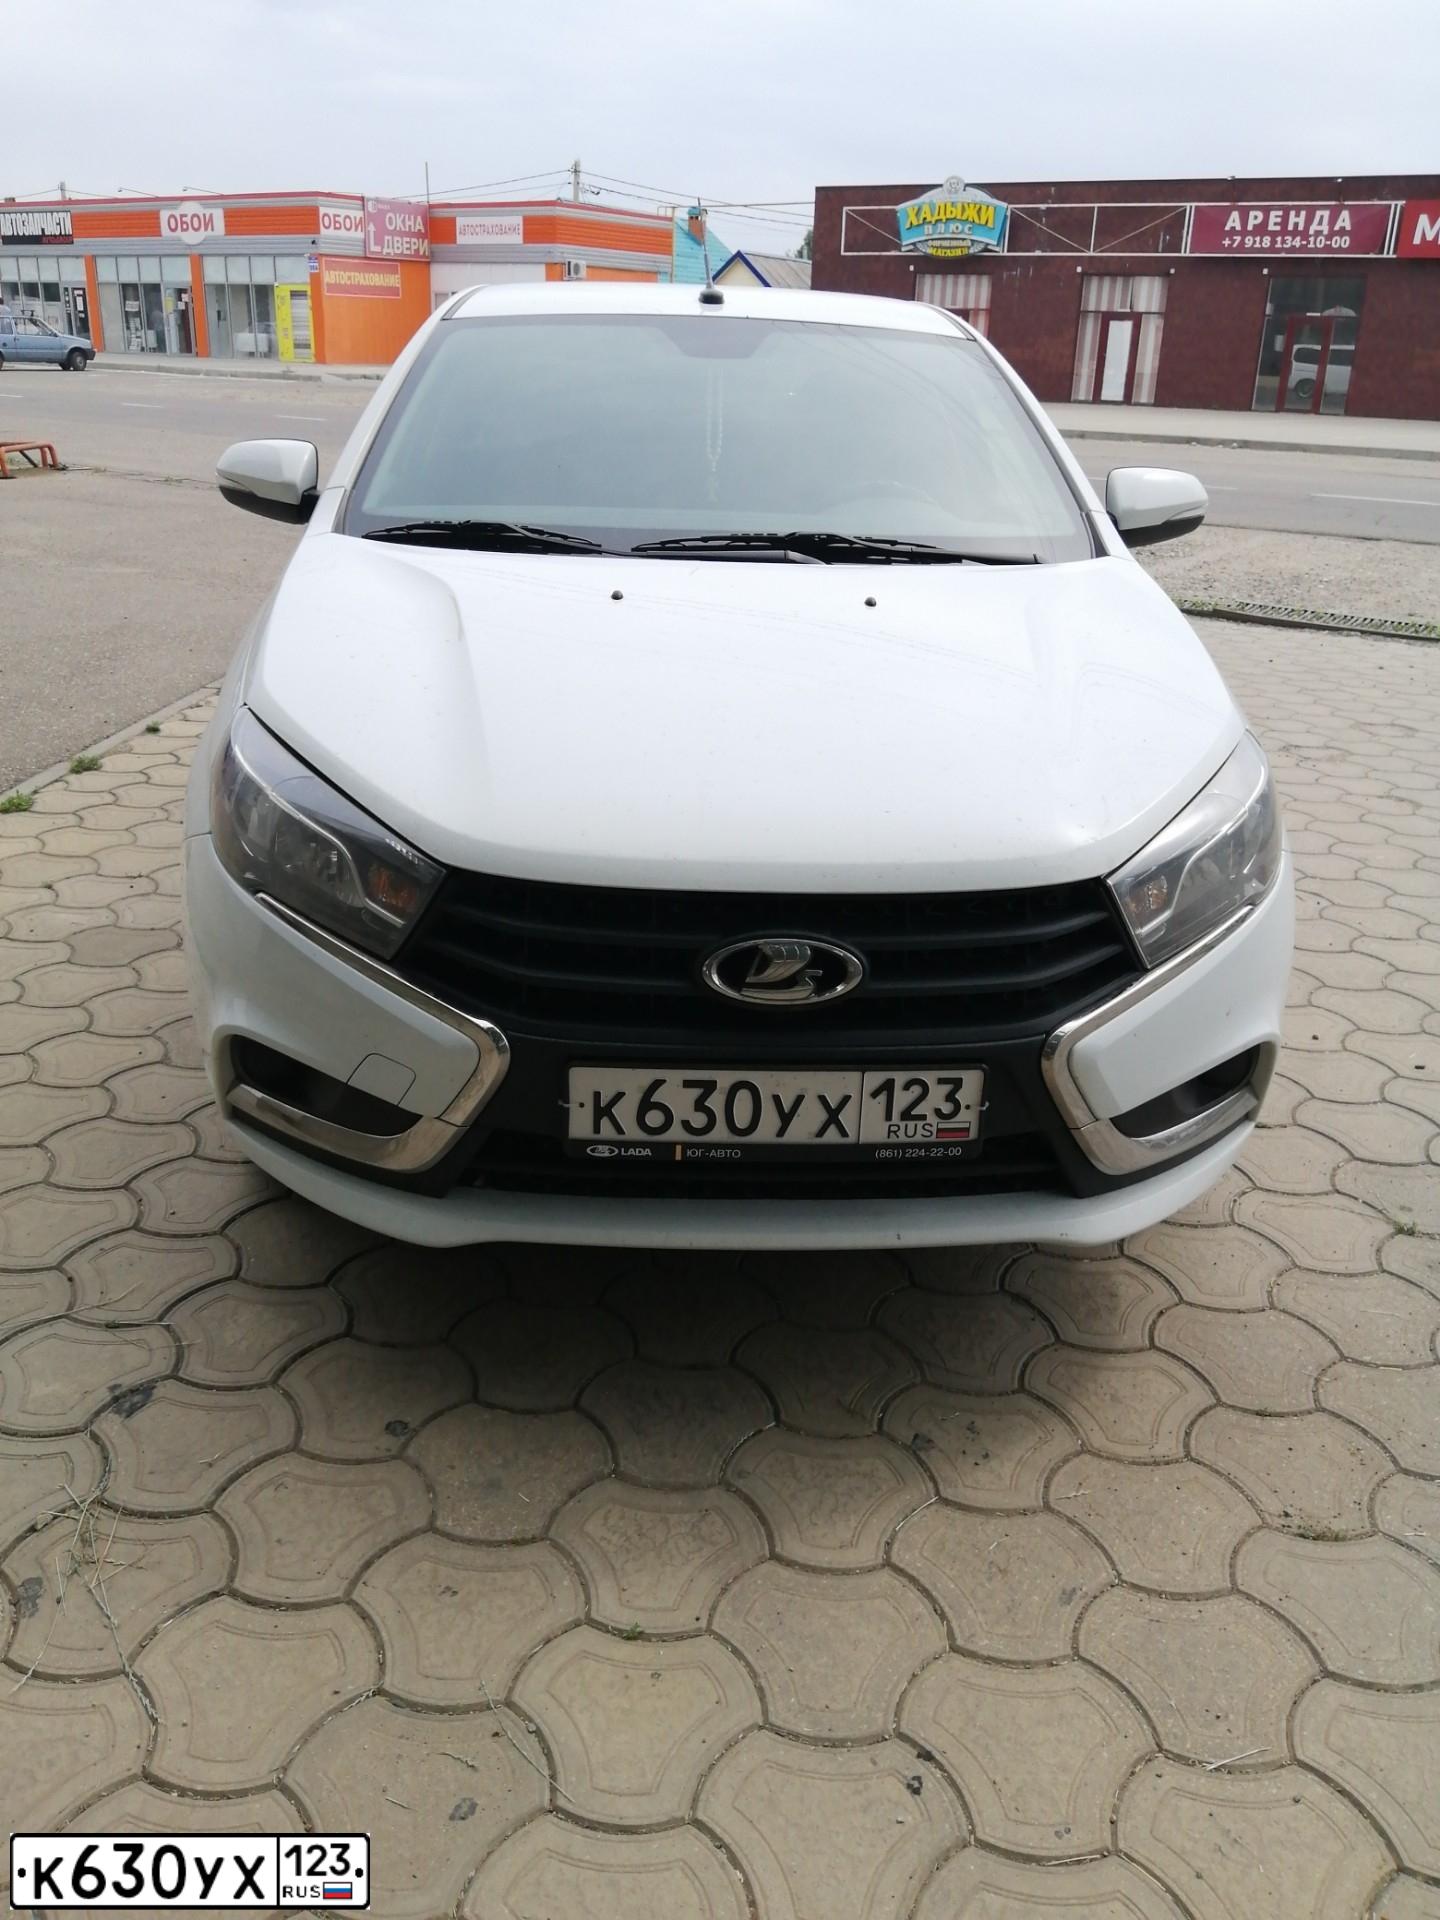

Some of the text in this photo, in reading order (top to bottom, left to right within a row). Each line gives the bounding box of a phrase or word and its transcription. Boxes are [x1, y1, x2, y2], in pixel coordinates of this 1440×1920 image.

[0, 212, 72, 236] АВТОЗАПЧАСТИ
[167, 213, 215, 232] ОБОИ
[321, 212, 364, 232] ОБОИ
[385, 212, 425, 233] ОКНА
[905, 202, 996, 230] ХАДЫЖИ
[1224, 210, 1351, 235] АРЕНДА
[458, 223, 520, 237] АВТОСТРАХОВАНИЕ
[924, 222, 974, 235] ПЛЮС
[382, 235, 429, 256] ДВЕРИ
[1222, 235, 1350, 248] +7 918 134-10-00
[325, 270, 400, 288] АВТОСТРАХОВАНИЕ
[592, 1077, 963, 1138] К630УХ 123
[887, 1123, 934, 1139] RUS
[620, 1148, 652, 1157] LADA
[686, 1148, 742, 1159] ЮГ-АВТО
[875, 1147, 962, 1160] (861) 224-22-00
